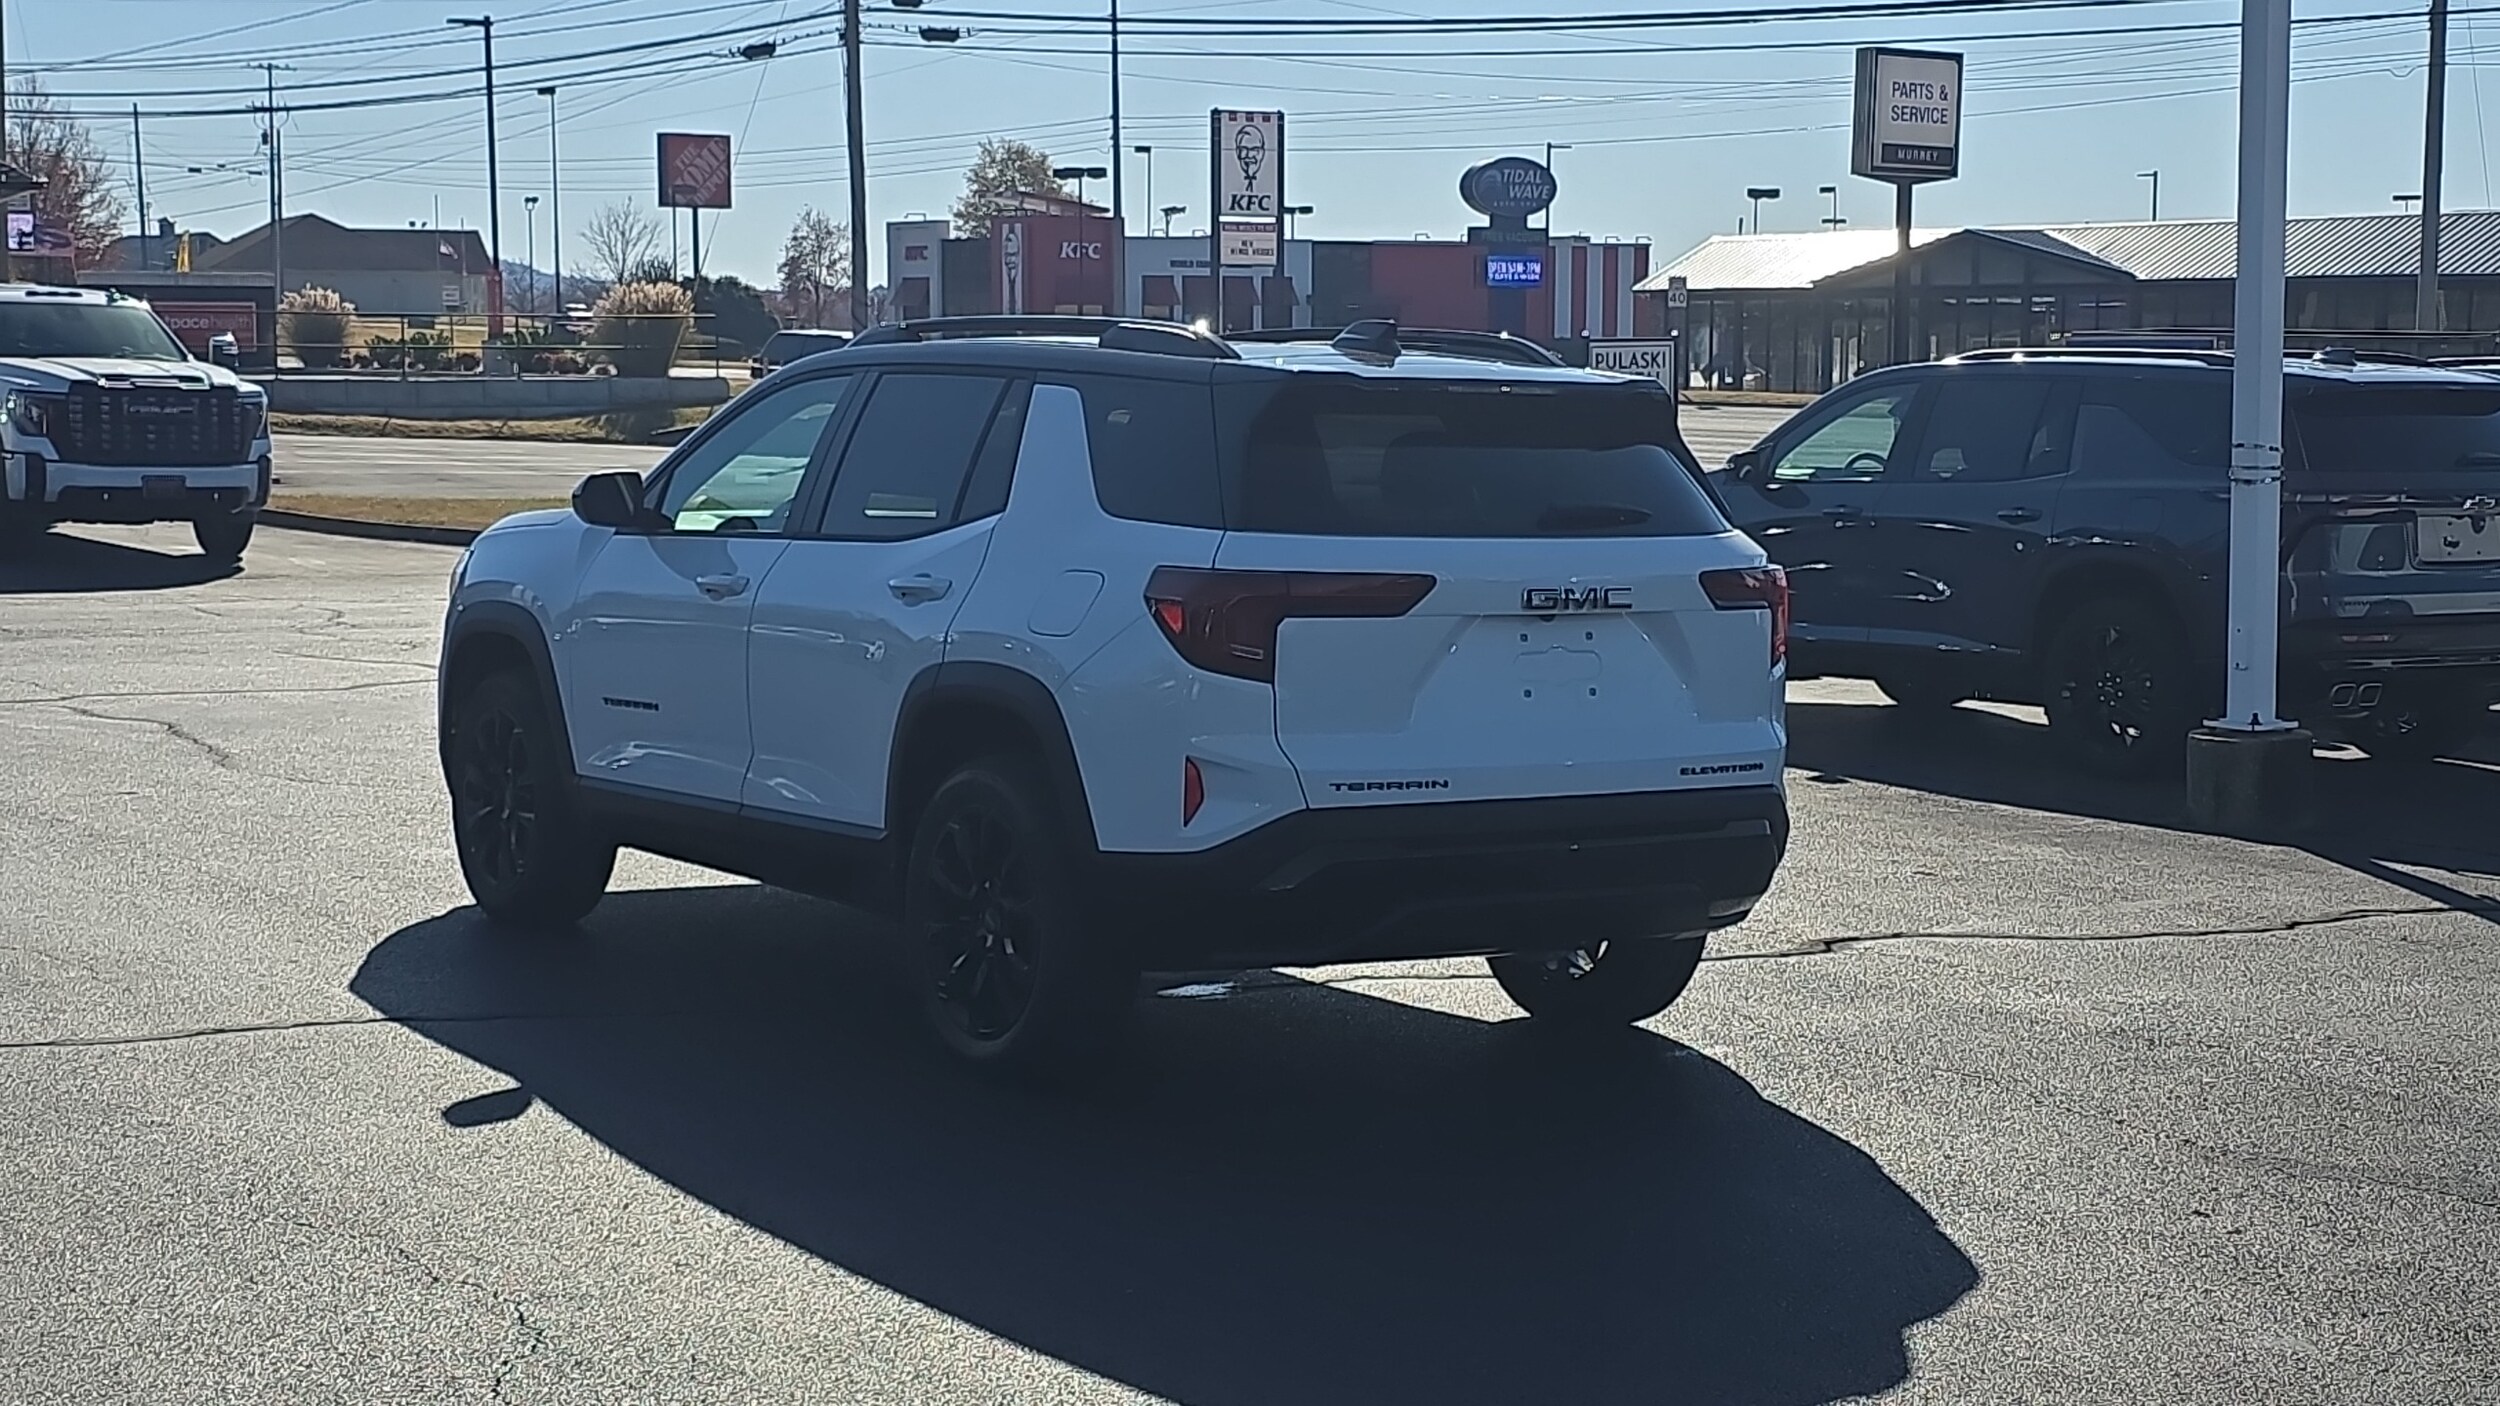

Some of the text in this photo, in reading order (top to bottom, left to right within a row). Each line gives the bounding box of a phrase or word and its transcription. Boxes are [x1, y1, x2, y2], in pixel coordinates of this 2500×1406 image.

[1891, 81, 1949, 101] PARTS &
[1890, 105, 1949, 124] SERVICE
[1503, 169, 1543, 183] TIDAL
[1509, 185, 1550, 199] WAVE
[1229, 193, 1272, 211] KFC
[1060, 242, 1102, 259] KFC
[1669, 293, 1686, 304] 40
[1595, 351, 1666, 369] PULASKI
[1521, 586, 1633, 610] GMC
[1680, 762, 1764, 776] ELEVATION
[1328, 780, 1449, 792] TERRAIN
